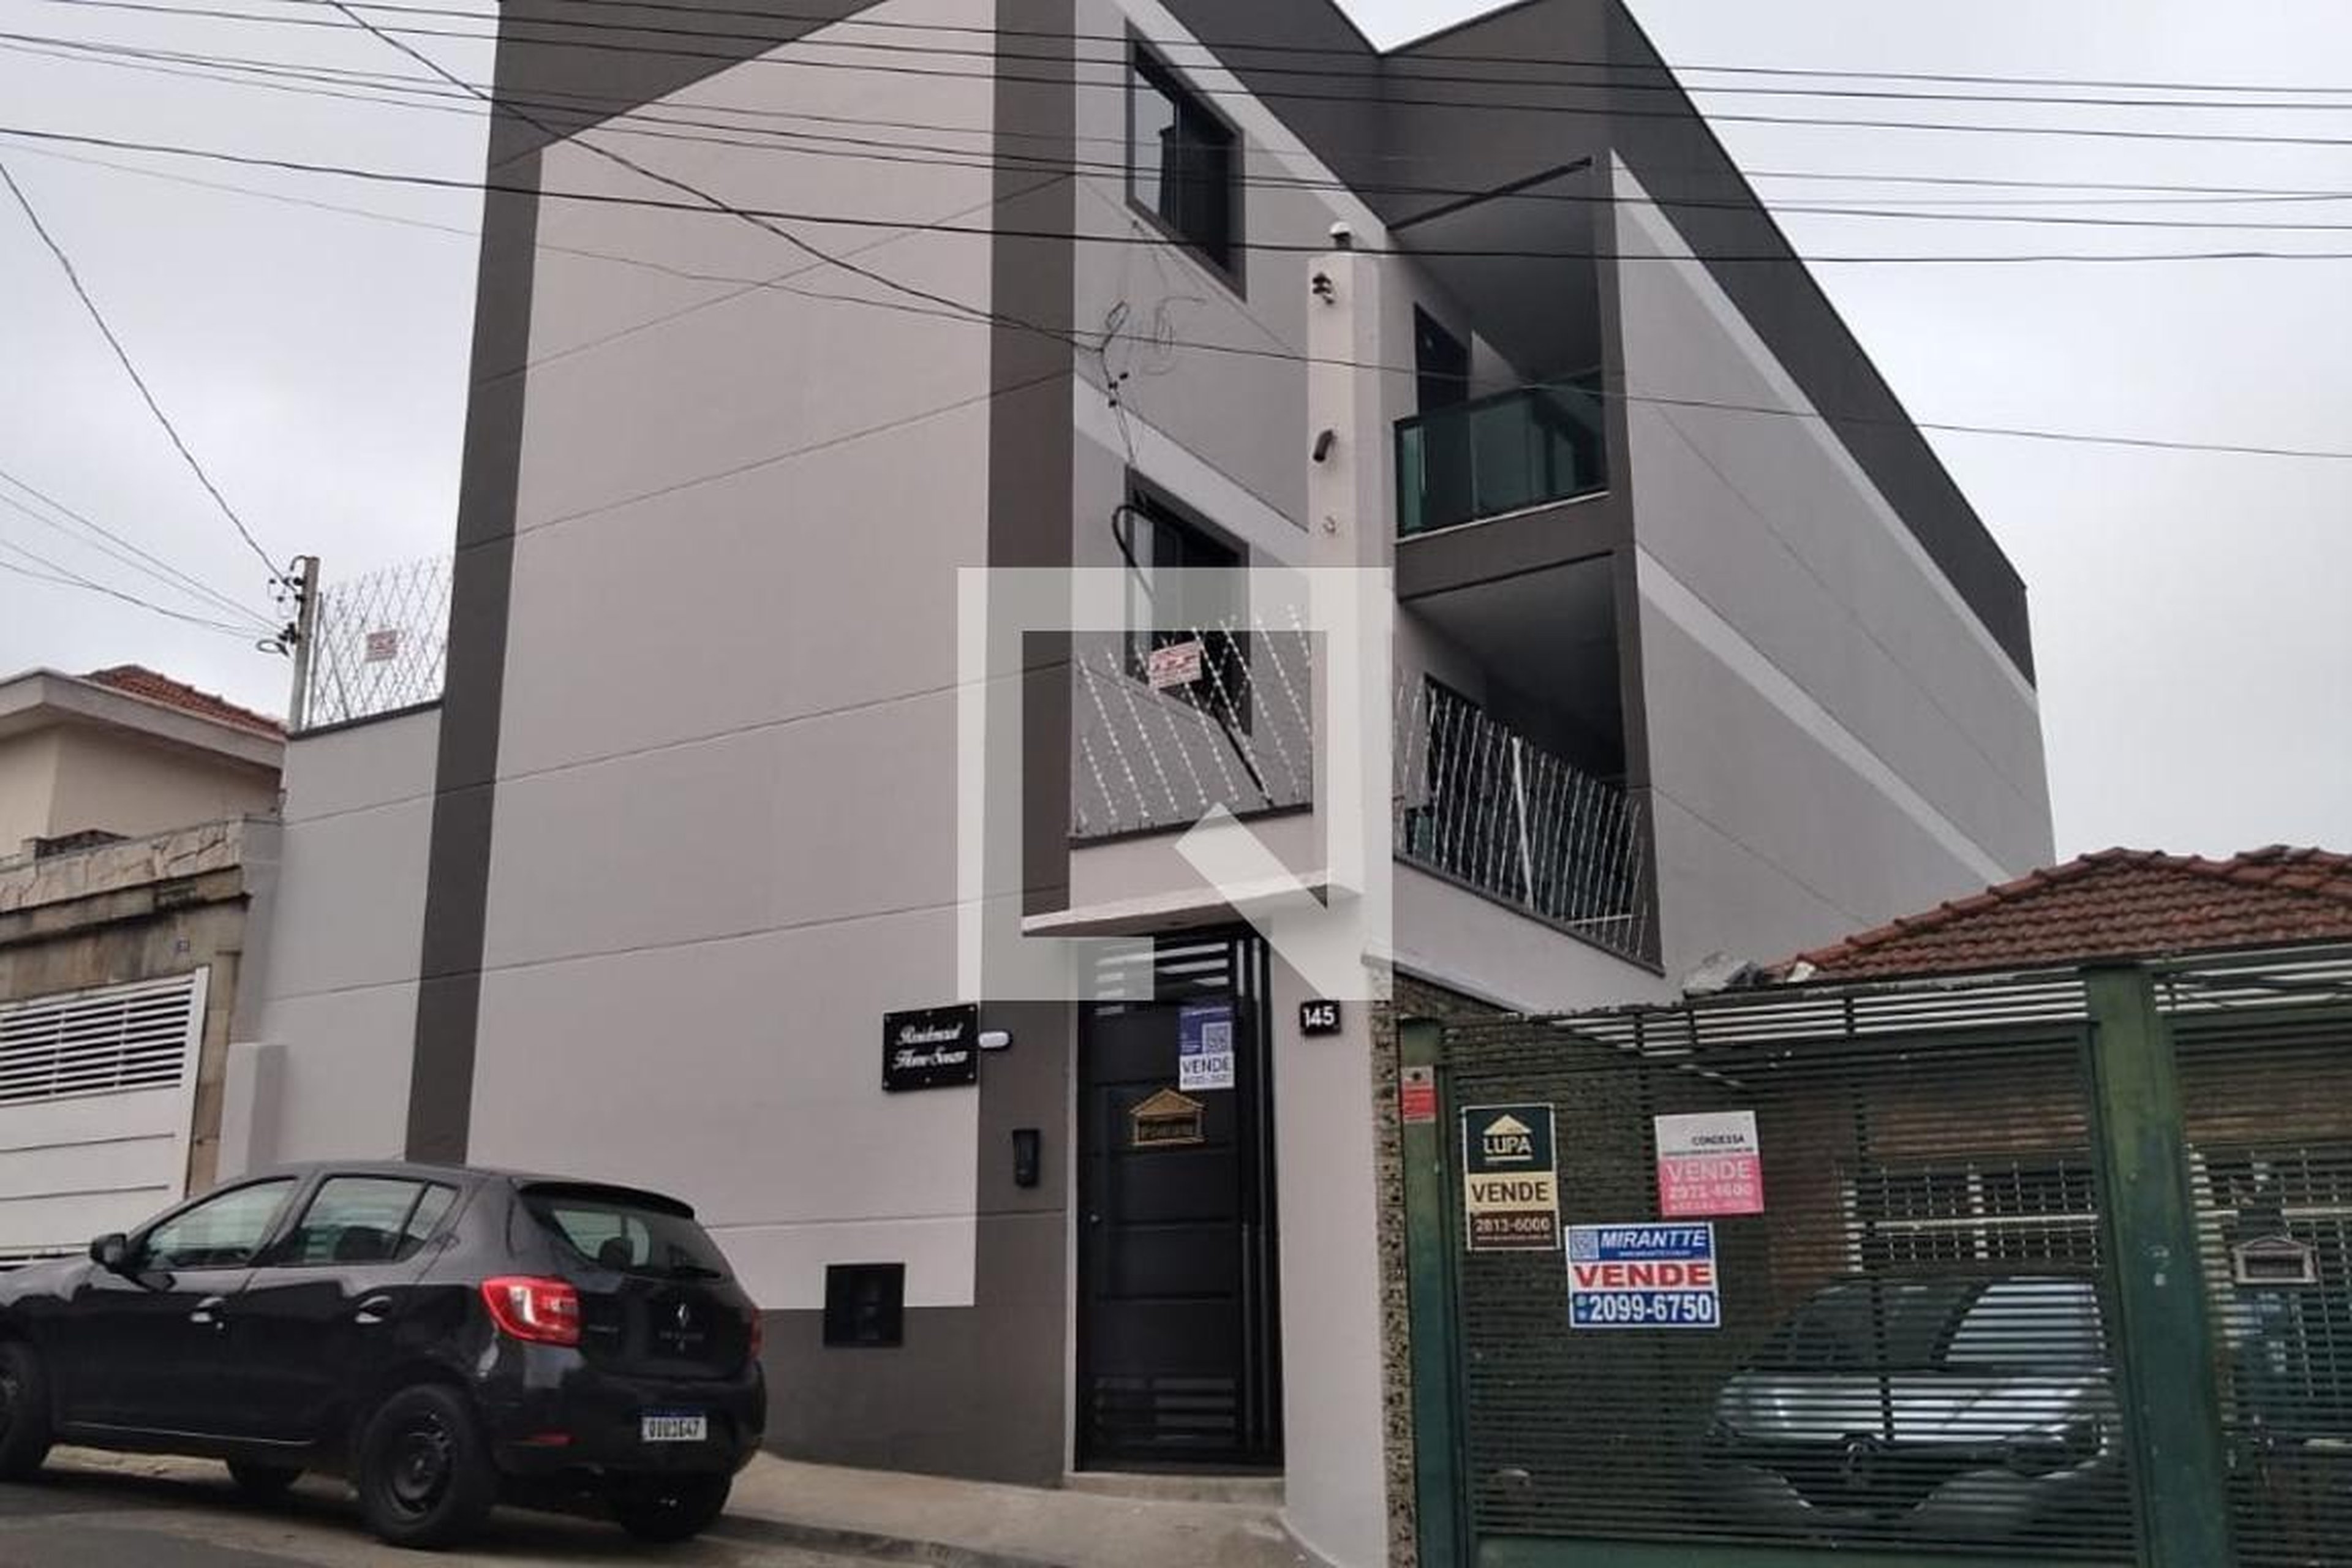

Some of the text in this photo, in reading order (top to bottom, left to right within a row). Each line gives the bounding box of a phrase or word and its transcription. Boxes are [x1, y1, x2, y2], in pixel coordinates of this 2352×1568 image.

[1303, 1006, 1335, 1028] 145
[1182, 1056, 1230, 1074] VENDE
[1483, 1136, 1532, 1155] LUPA
[1666, 1159, 1754, 1183] VENDE
[1472, 1181, 1550, 1203] VENDE
[1600, 1229, 1707, 1248] MIRANTTE
[1573, 1263, 1713, 1289] VENDE
[1589, 1294, 1713, 1321] 2099-6750
